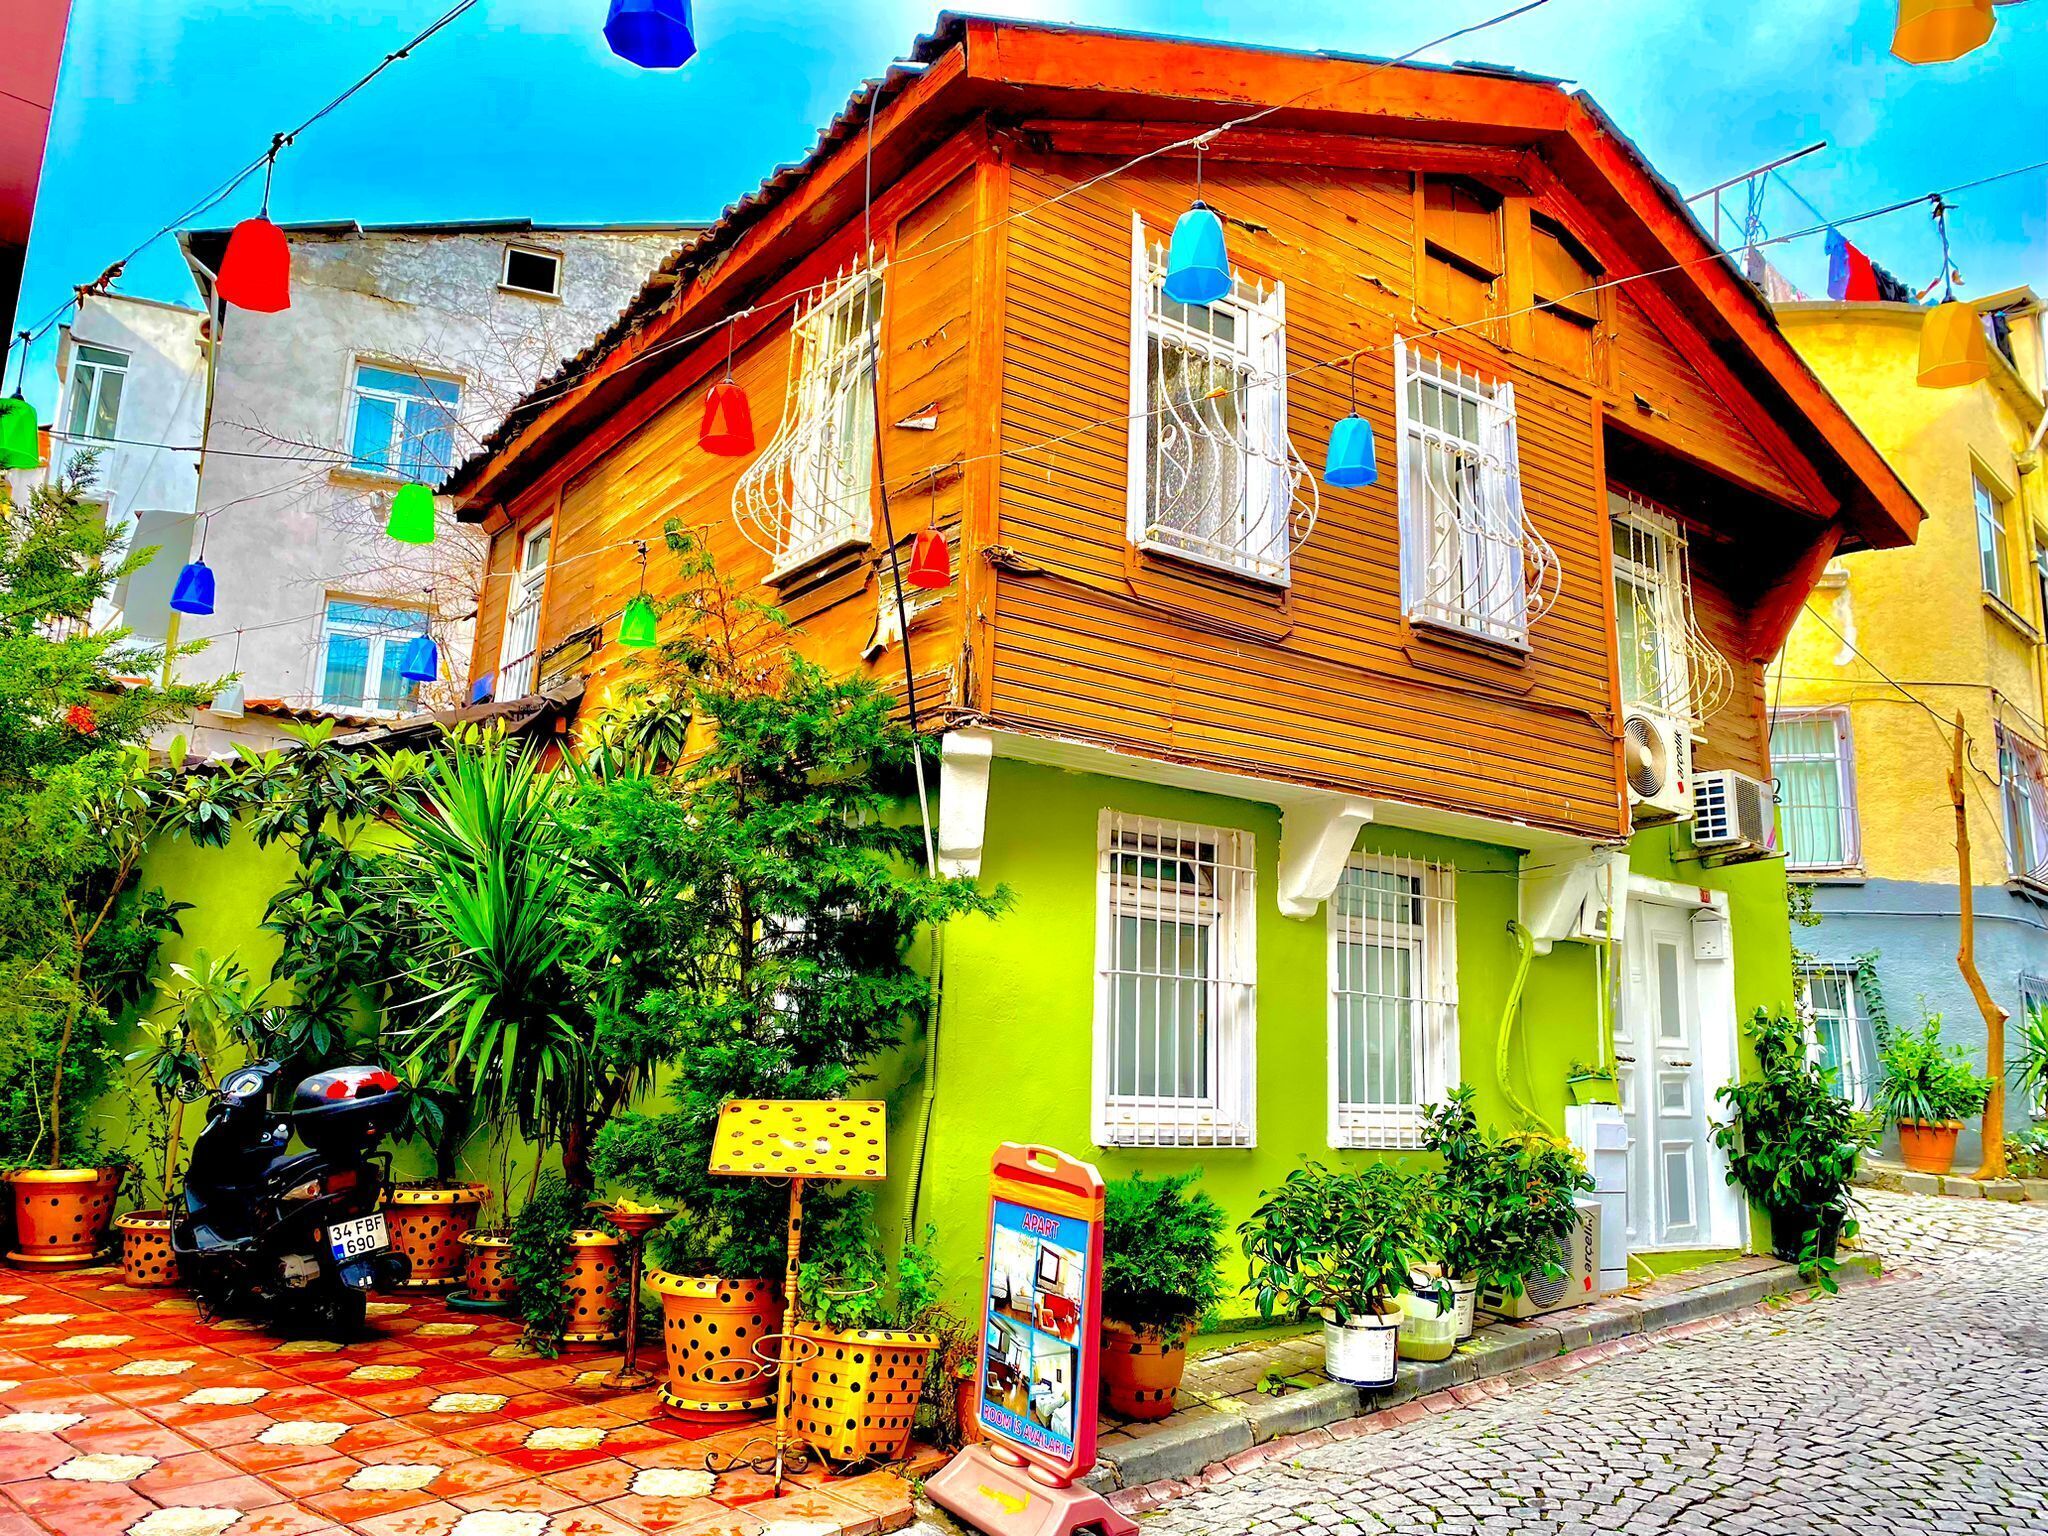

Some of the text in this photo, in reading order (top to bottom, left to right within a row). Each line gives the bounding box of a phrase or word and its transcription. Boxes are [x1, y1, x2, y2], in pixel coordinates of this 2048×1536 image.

[332, 1215, 382, 1241] 34 FBF
[1022, 1211, 1060, 1239] APART
[346, 1234, 375, 1254] 690
[983, 1404, 1012, 1431] ROOM
